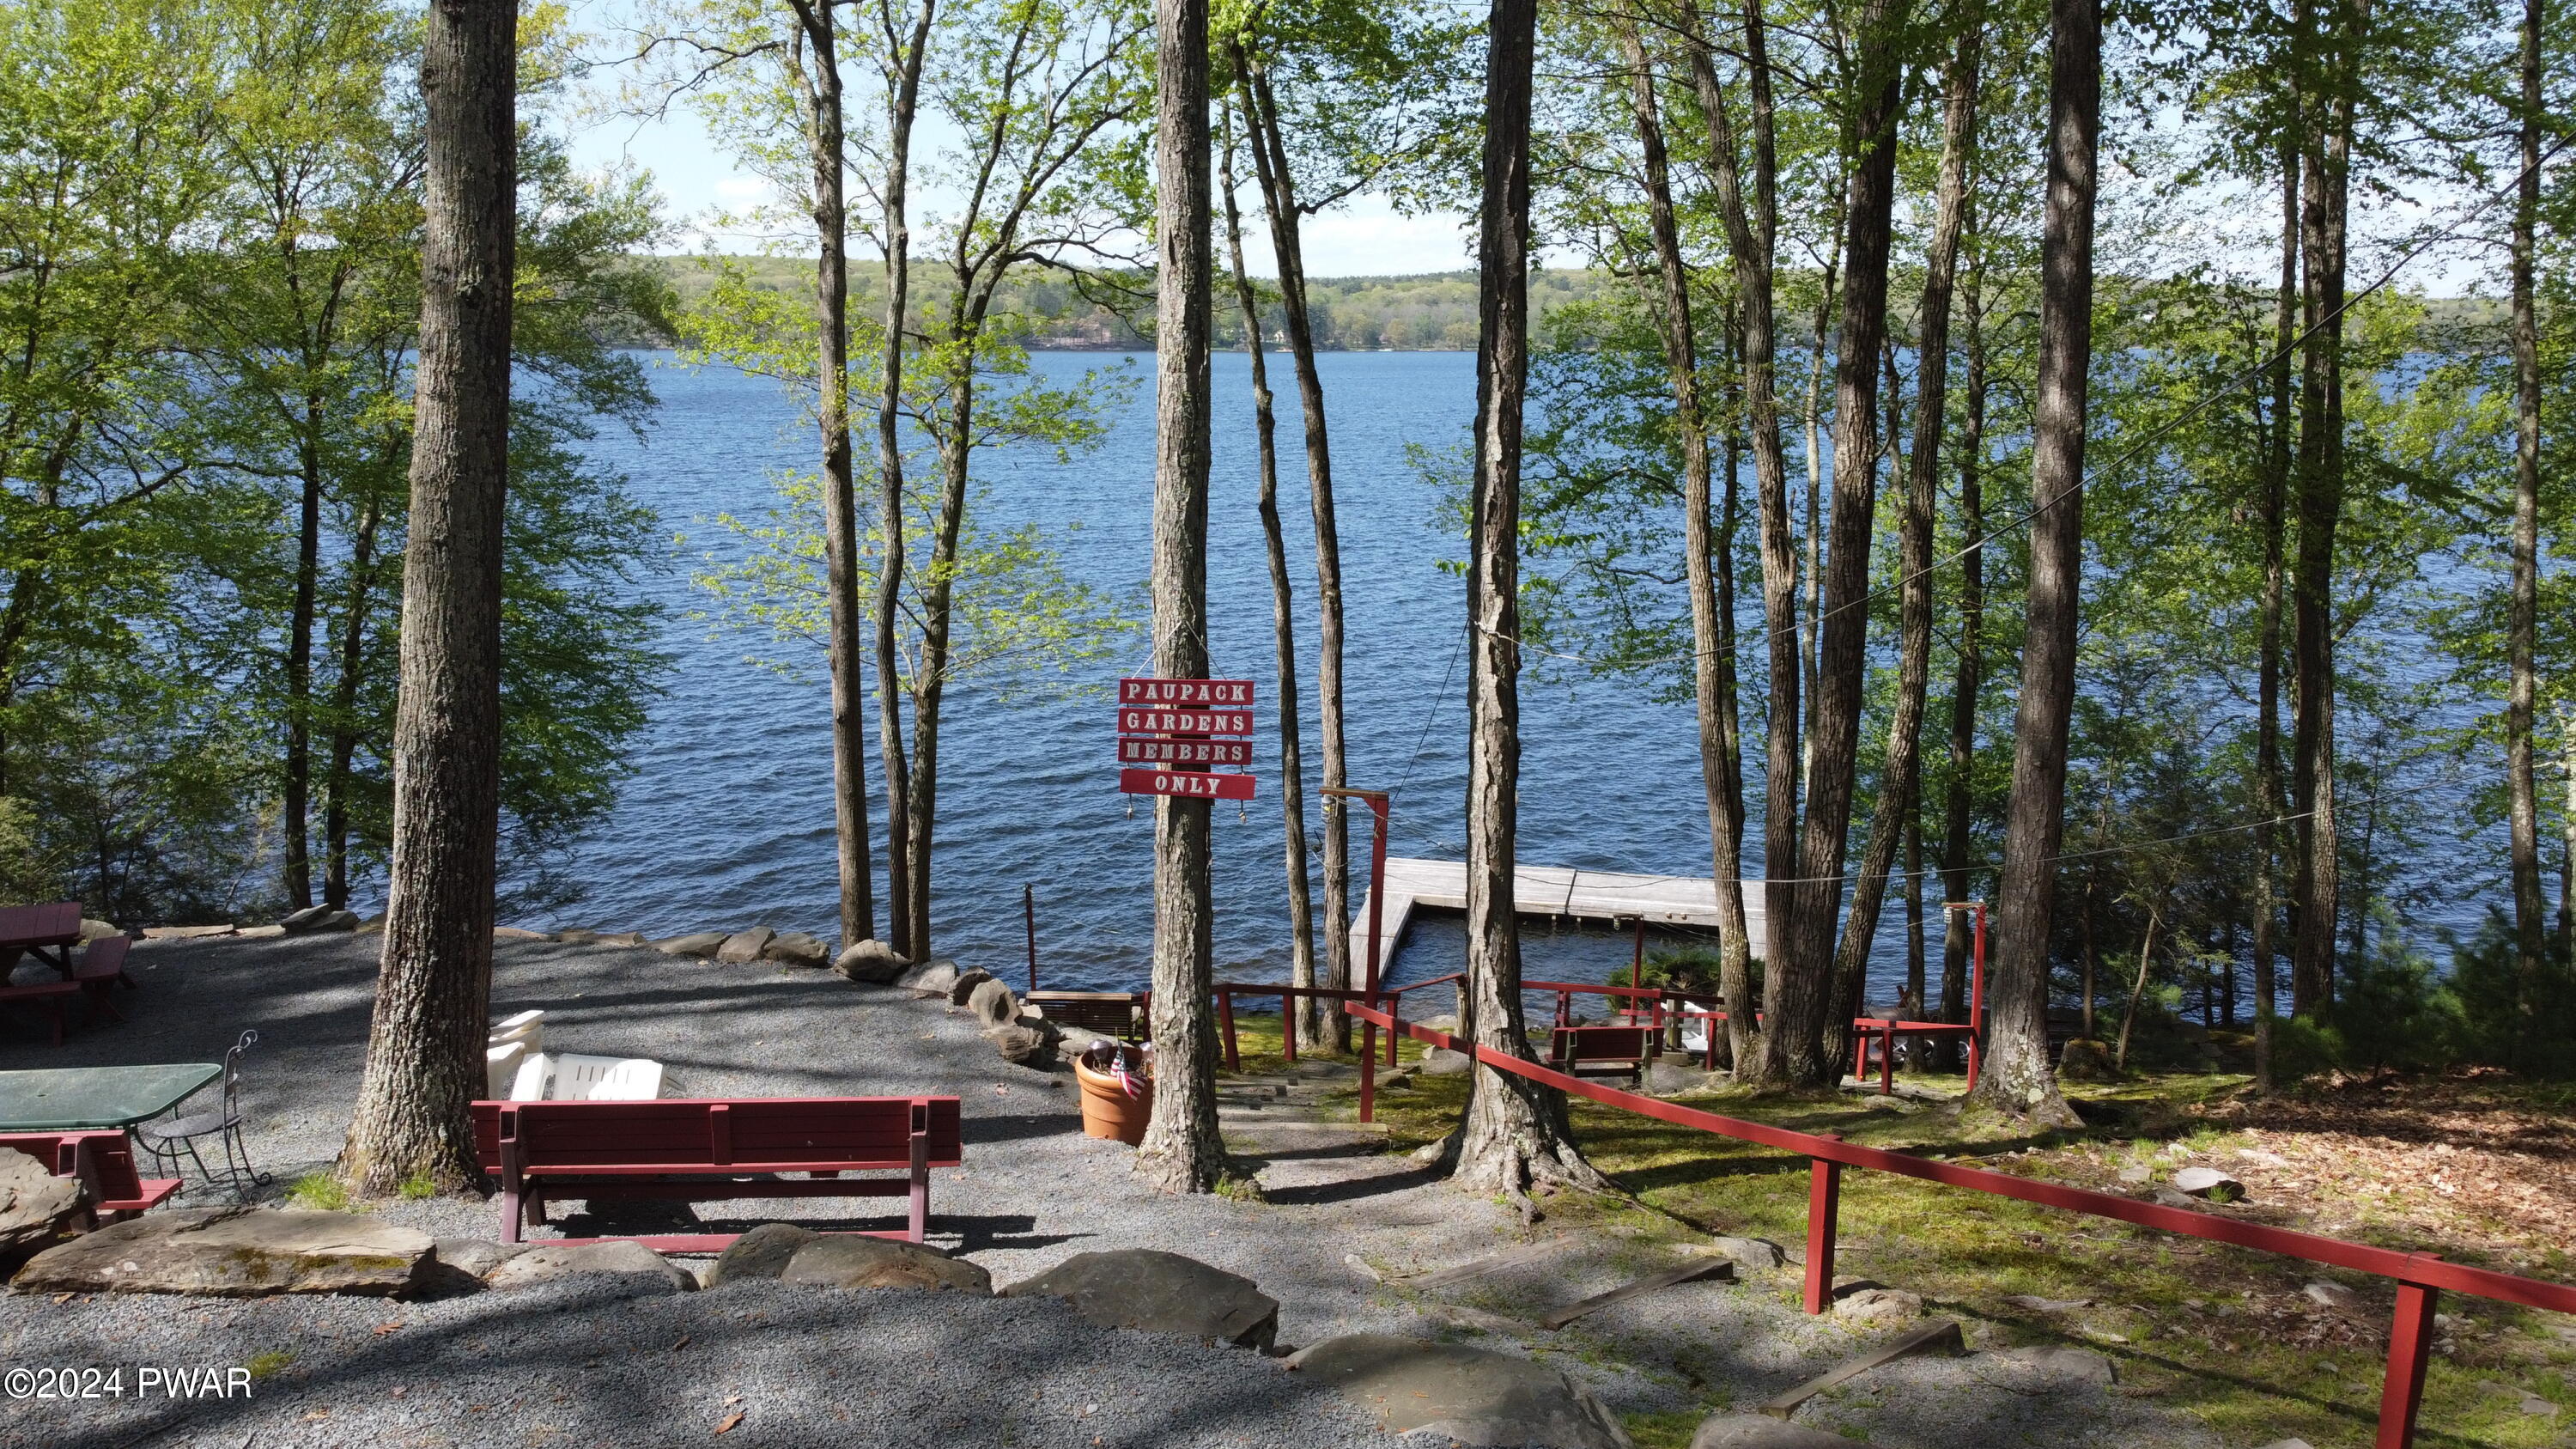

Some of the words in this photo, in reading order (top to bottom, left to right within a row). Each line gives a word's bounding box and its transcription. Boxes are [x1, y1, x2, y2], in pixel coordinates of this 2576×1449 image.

[1127, 683, 1245, 701] PAUPACK
[1127, 712, 1245, 732] GARDENS
[1126, 742, 1243, 762] MEMBERS
[1155, 776, 1221, 795] ONLY
